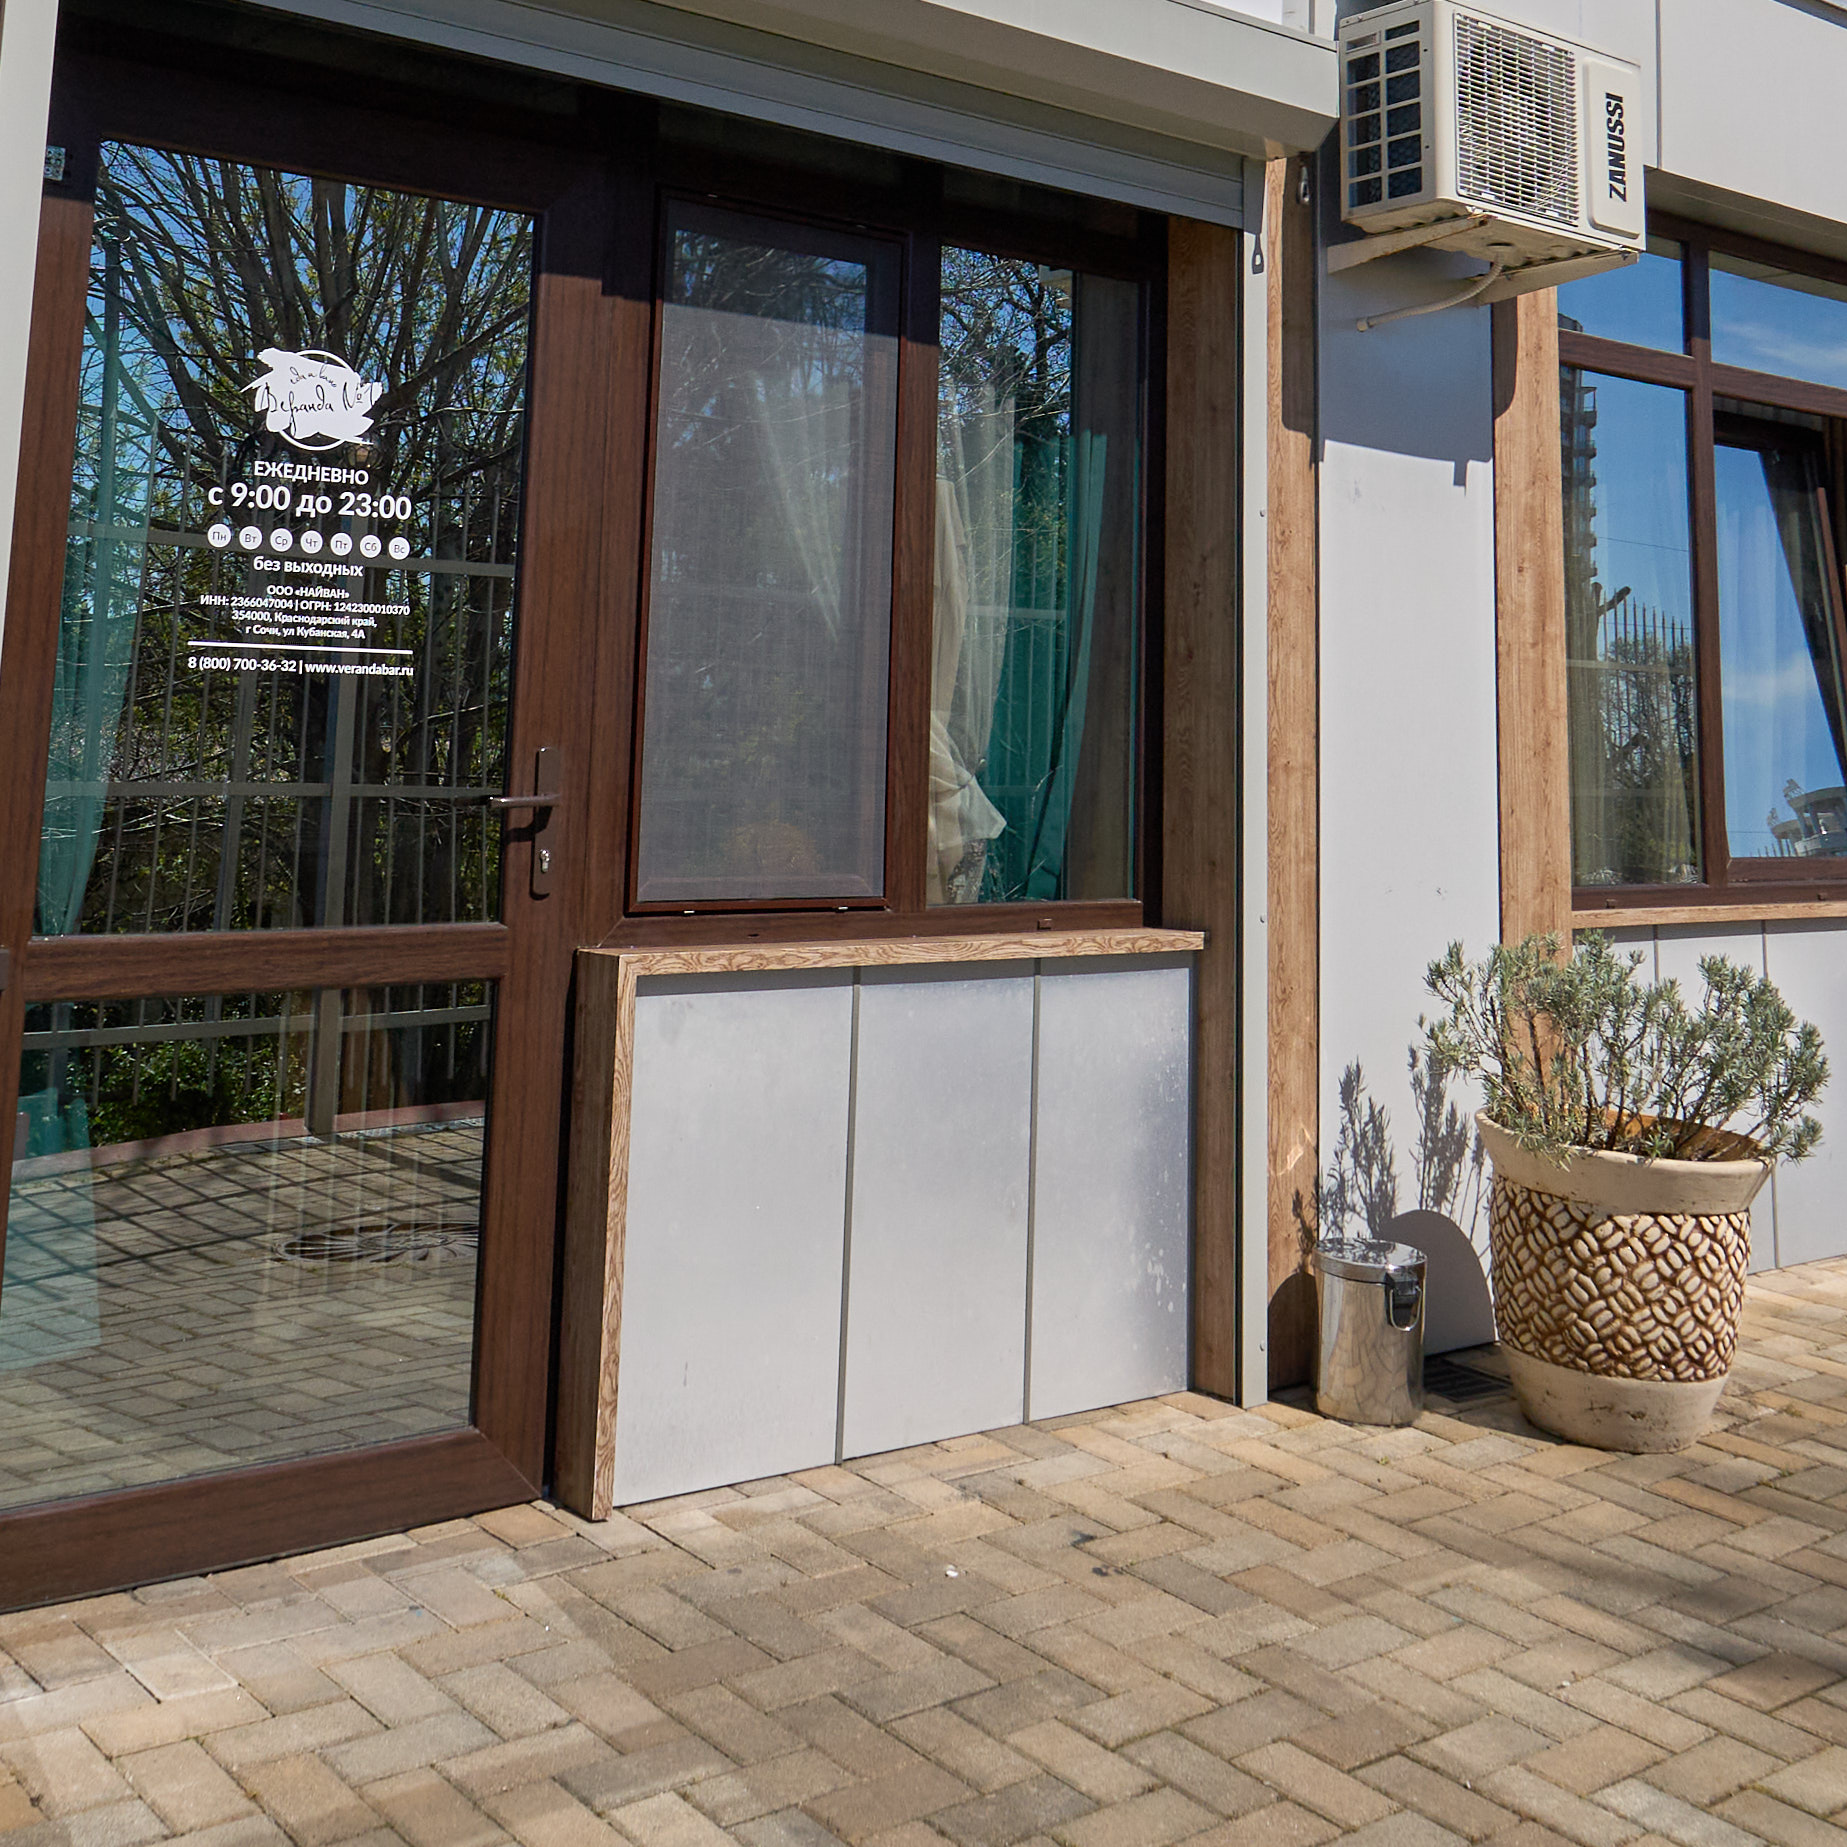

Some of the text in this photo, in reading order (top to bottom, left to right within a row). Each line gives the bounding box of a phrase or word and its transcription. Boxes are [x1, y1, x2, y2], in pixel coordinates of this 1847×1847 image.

[1605, 92, 1627, 202] ZANUSSI
[259, 382, 334, 437] Веранда
[254, 460, 369, 485] ЕЖЕДНЕВНО
[208, 482, 412, 520] с 9:00 до 23:00
[212, 531, 405, 554] Пн Вт Ср Чт Пт Сб Вс
[253, 556, 364, 578] без выходных
[266, 585, 350, 599] ООО «НАЙВАН»
[200, 595, 410, 615] ИНН: 2366047004 ОГРН: 1242300010370
[231, 610, 378, 628] 354000, Краснодарский край,
[246, 626, 251, 634] г
[253, 624, 281, 636] Сочи,
[282, 628, 295, 638] ул
[296, 628, 350, 640] Кубанская,
[187, 656, 414, 676] 8 (800) 700-36-32 www.verandabar.ru
